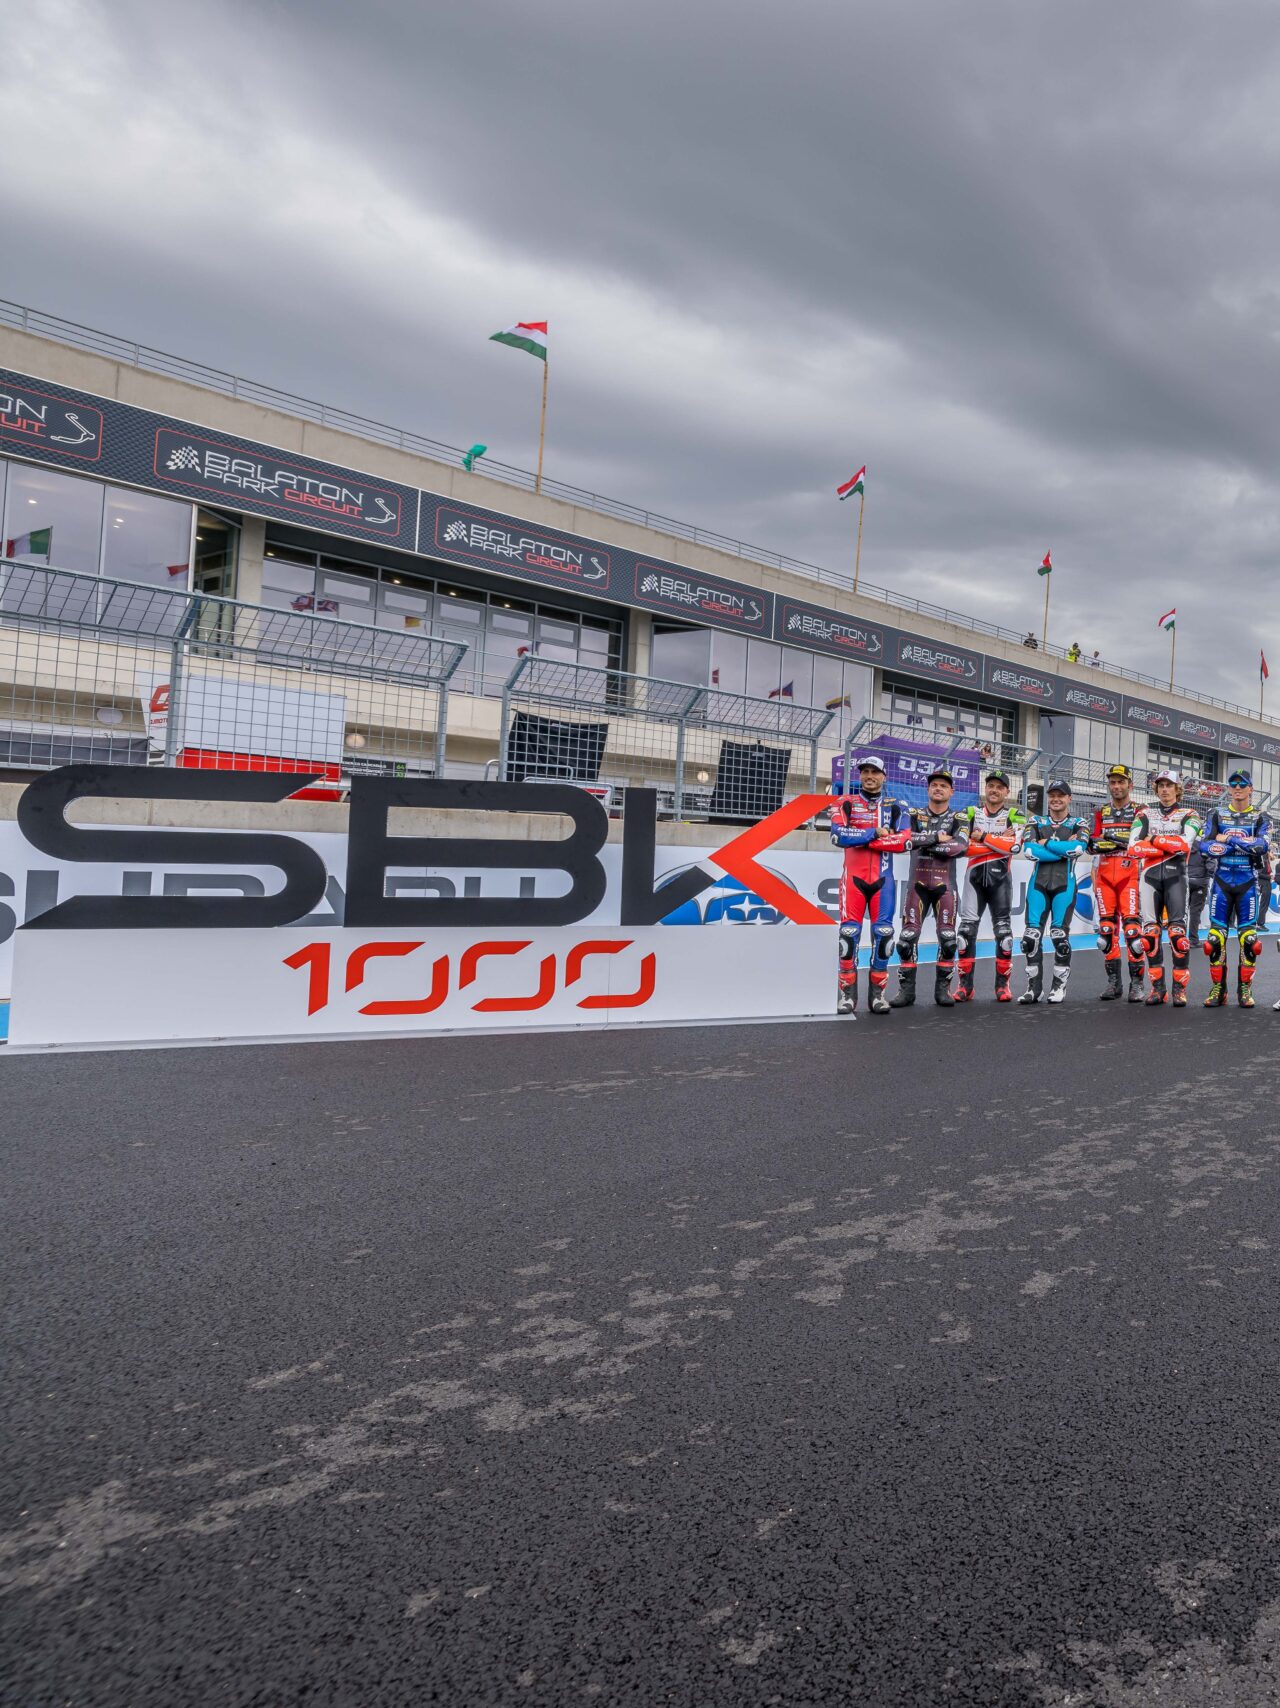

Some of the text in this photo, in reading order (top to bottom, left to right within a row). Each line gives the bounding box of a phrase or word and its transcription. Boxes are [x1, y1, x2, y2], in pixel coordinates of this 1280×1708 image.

[204, 467, 363, 519] PARK CIRCUIT
[205, 450, 364, 507] BALATON
[469, 536, 583, 576] PARK CIRCUIT
[470, 523, 583, 565] BALATON
[659, 588, 744, 617] PARK CIRCUIT
[660, 576, 745, 608] BALATON
[802, 624, 867, 649] PARK CIRCUIT
[803, 615, 868, 641] BALATON
[913, 646, 965, 667] BALATON
[15, 764, 842, 929] SBK
[1129, 887, 1137, 916] DUCATI
[282, 940, 656, 1016] 1000
